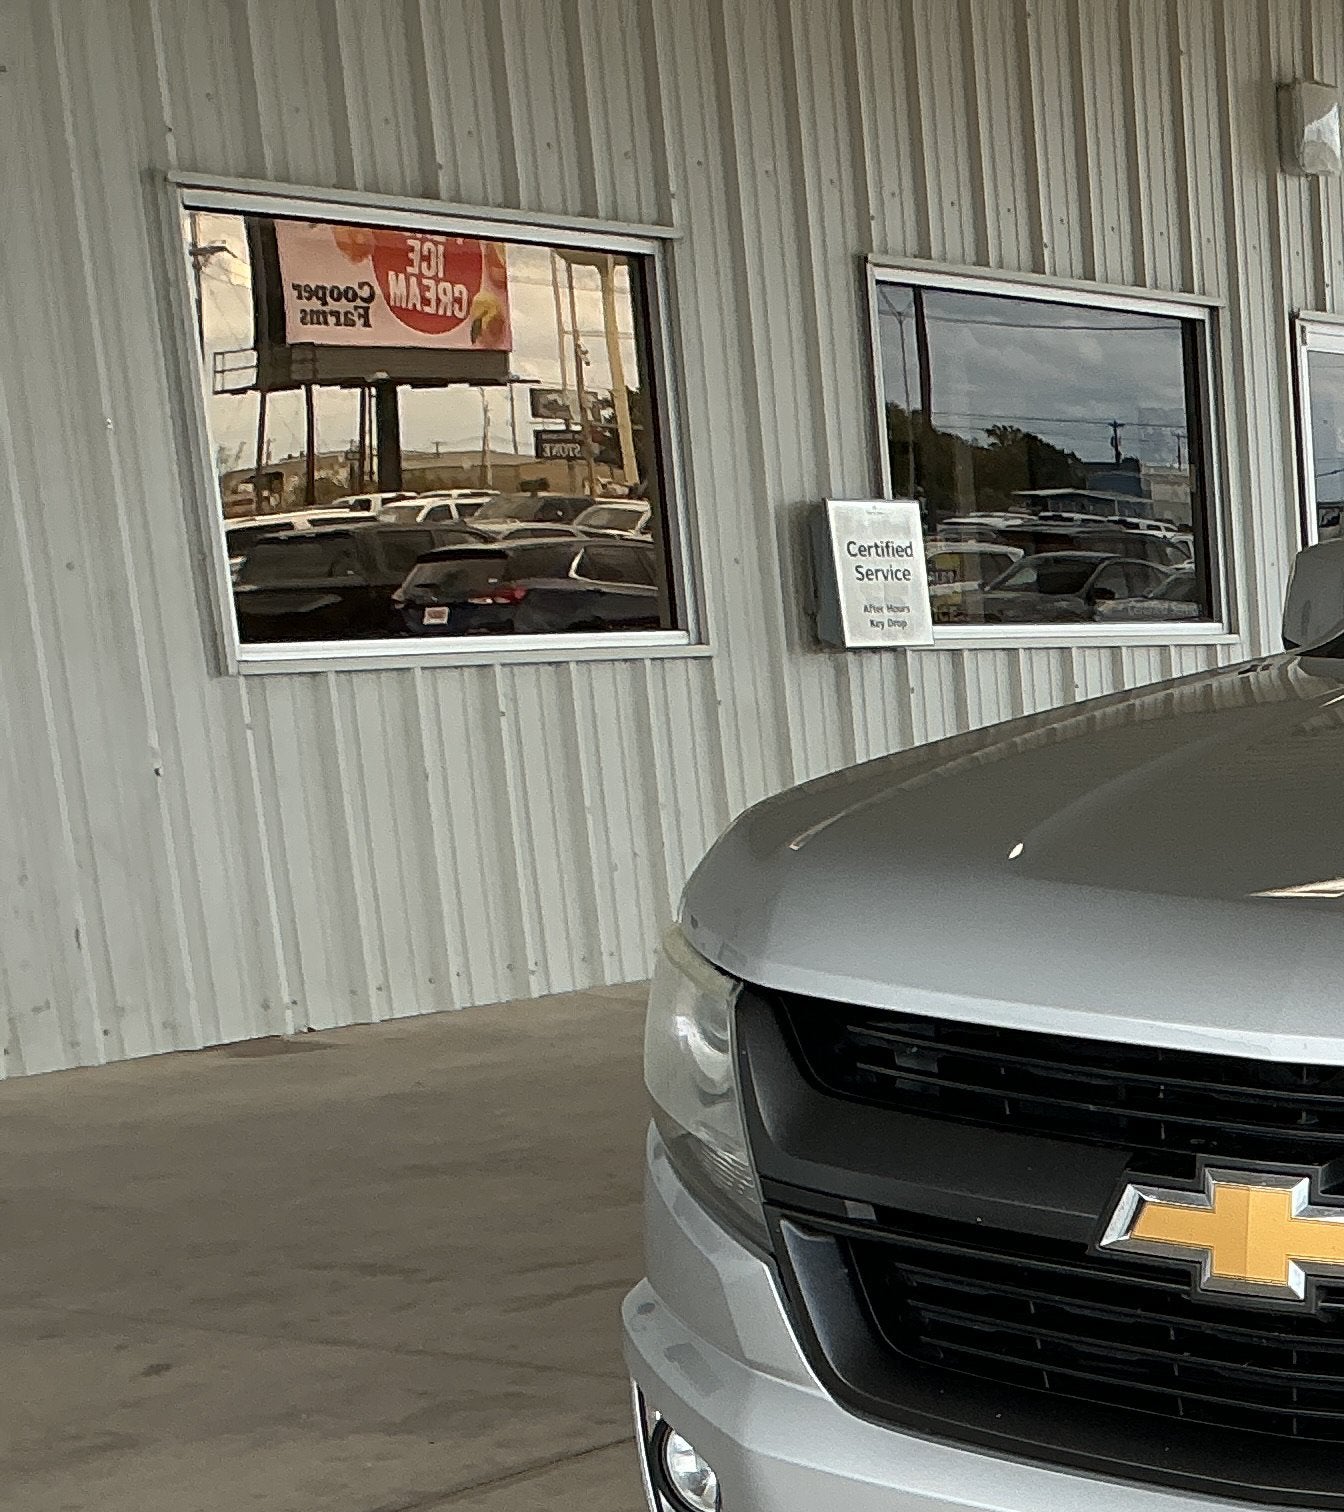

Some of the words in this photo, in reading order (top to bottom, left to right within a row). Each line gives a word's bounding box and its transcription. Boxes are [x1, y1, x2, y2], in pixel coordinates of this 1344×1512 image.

[846, 540, 914, 558] Certified
[855, 565, 911, 581] Service
[863, 604, 884, 613] After
[886, 604, 910, 613] Hours
[887, 619, 907, 630] Drop
